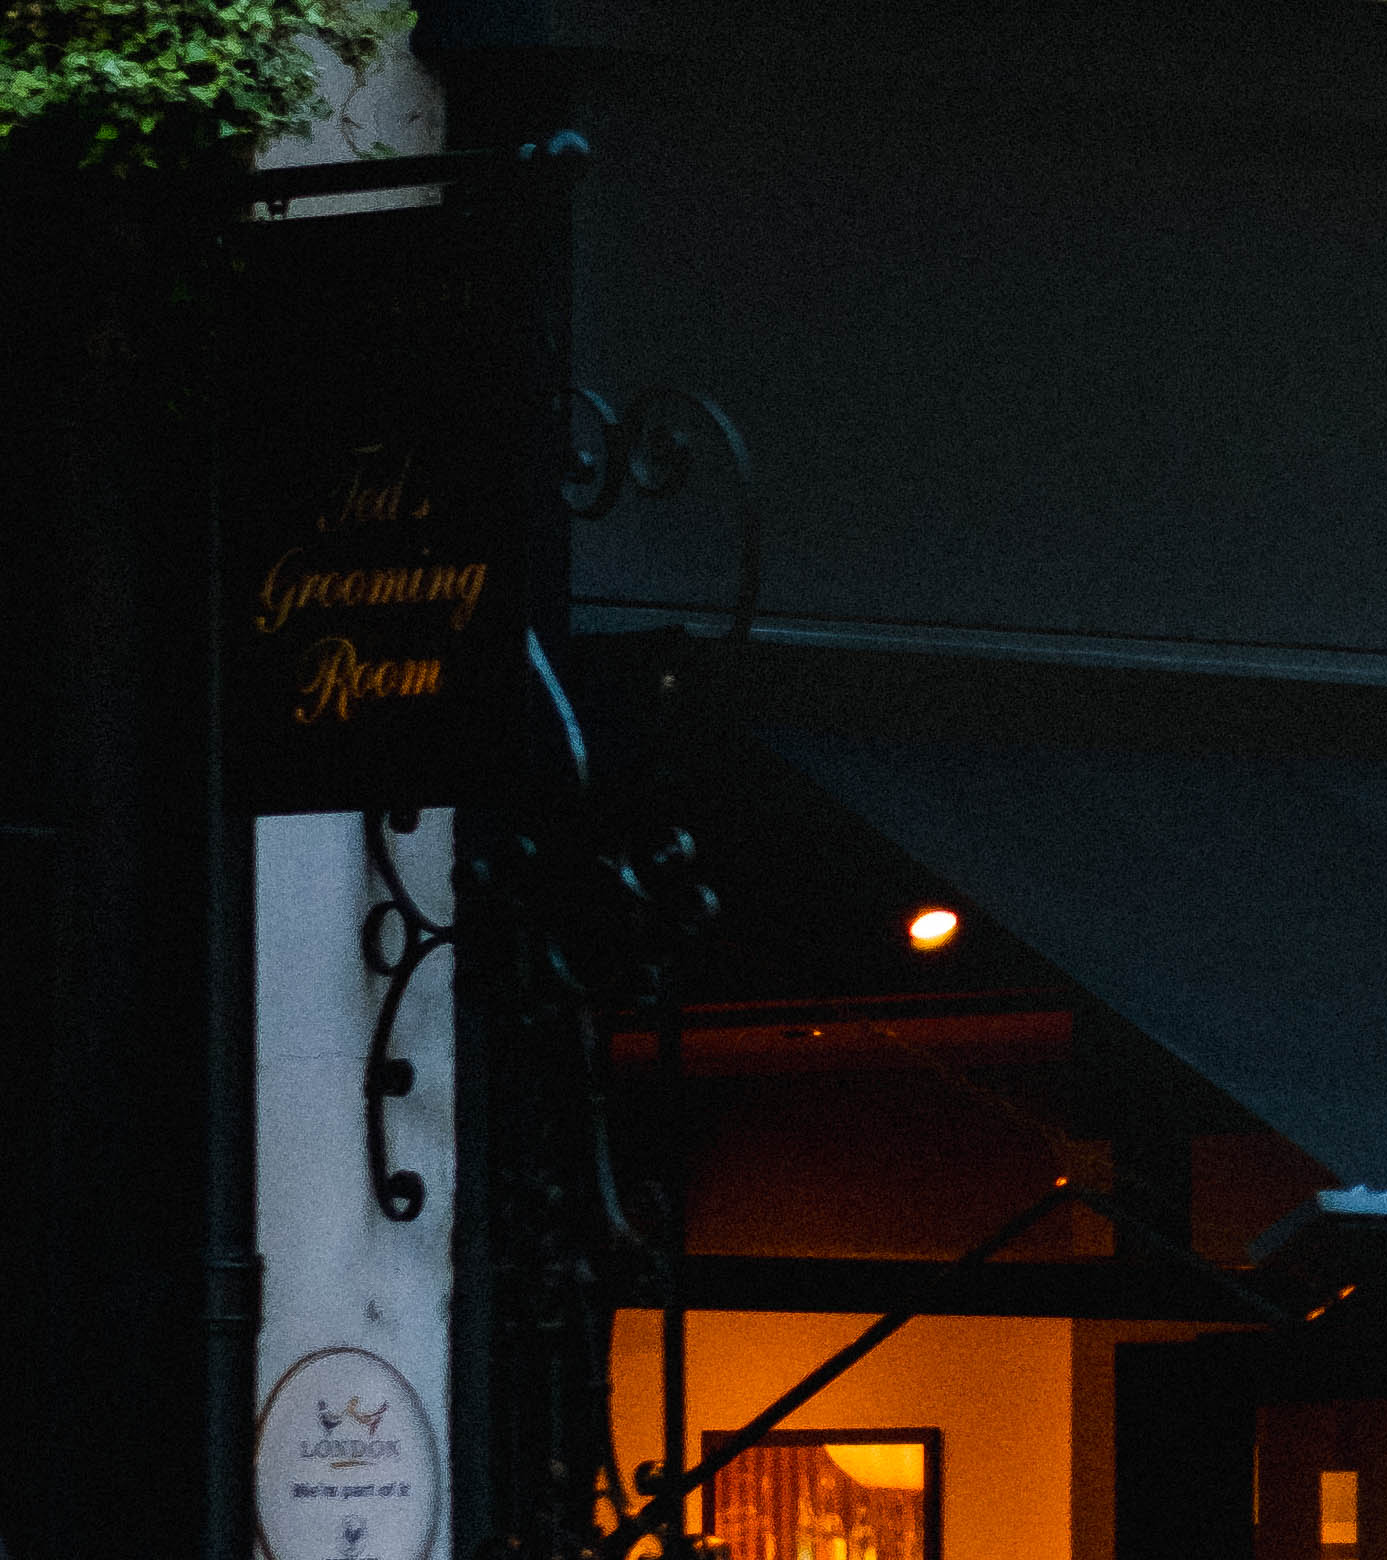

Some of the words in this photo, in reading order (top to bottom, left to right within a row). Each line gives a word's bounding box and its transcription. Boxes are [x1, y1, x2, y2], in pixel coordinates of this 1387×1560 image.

[254, 546, 488, 633] Grooming
[294, 635, 442, 724] Room
[300, 1439, 400, 1458] LONDON
[342, 1483, 375, 1500] part
[378, 1482, 397, 1497] of
